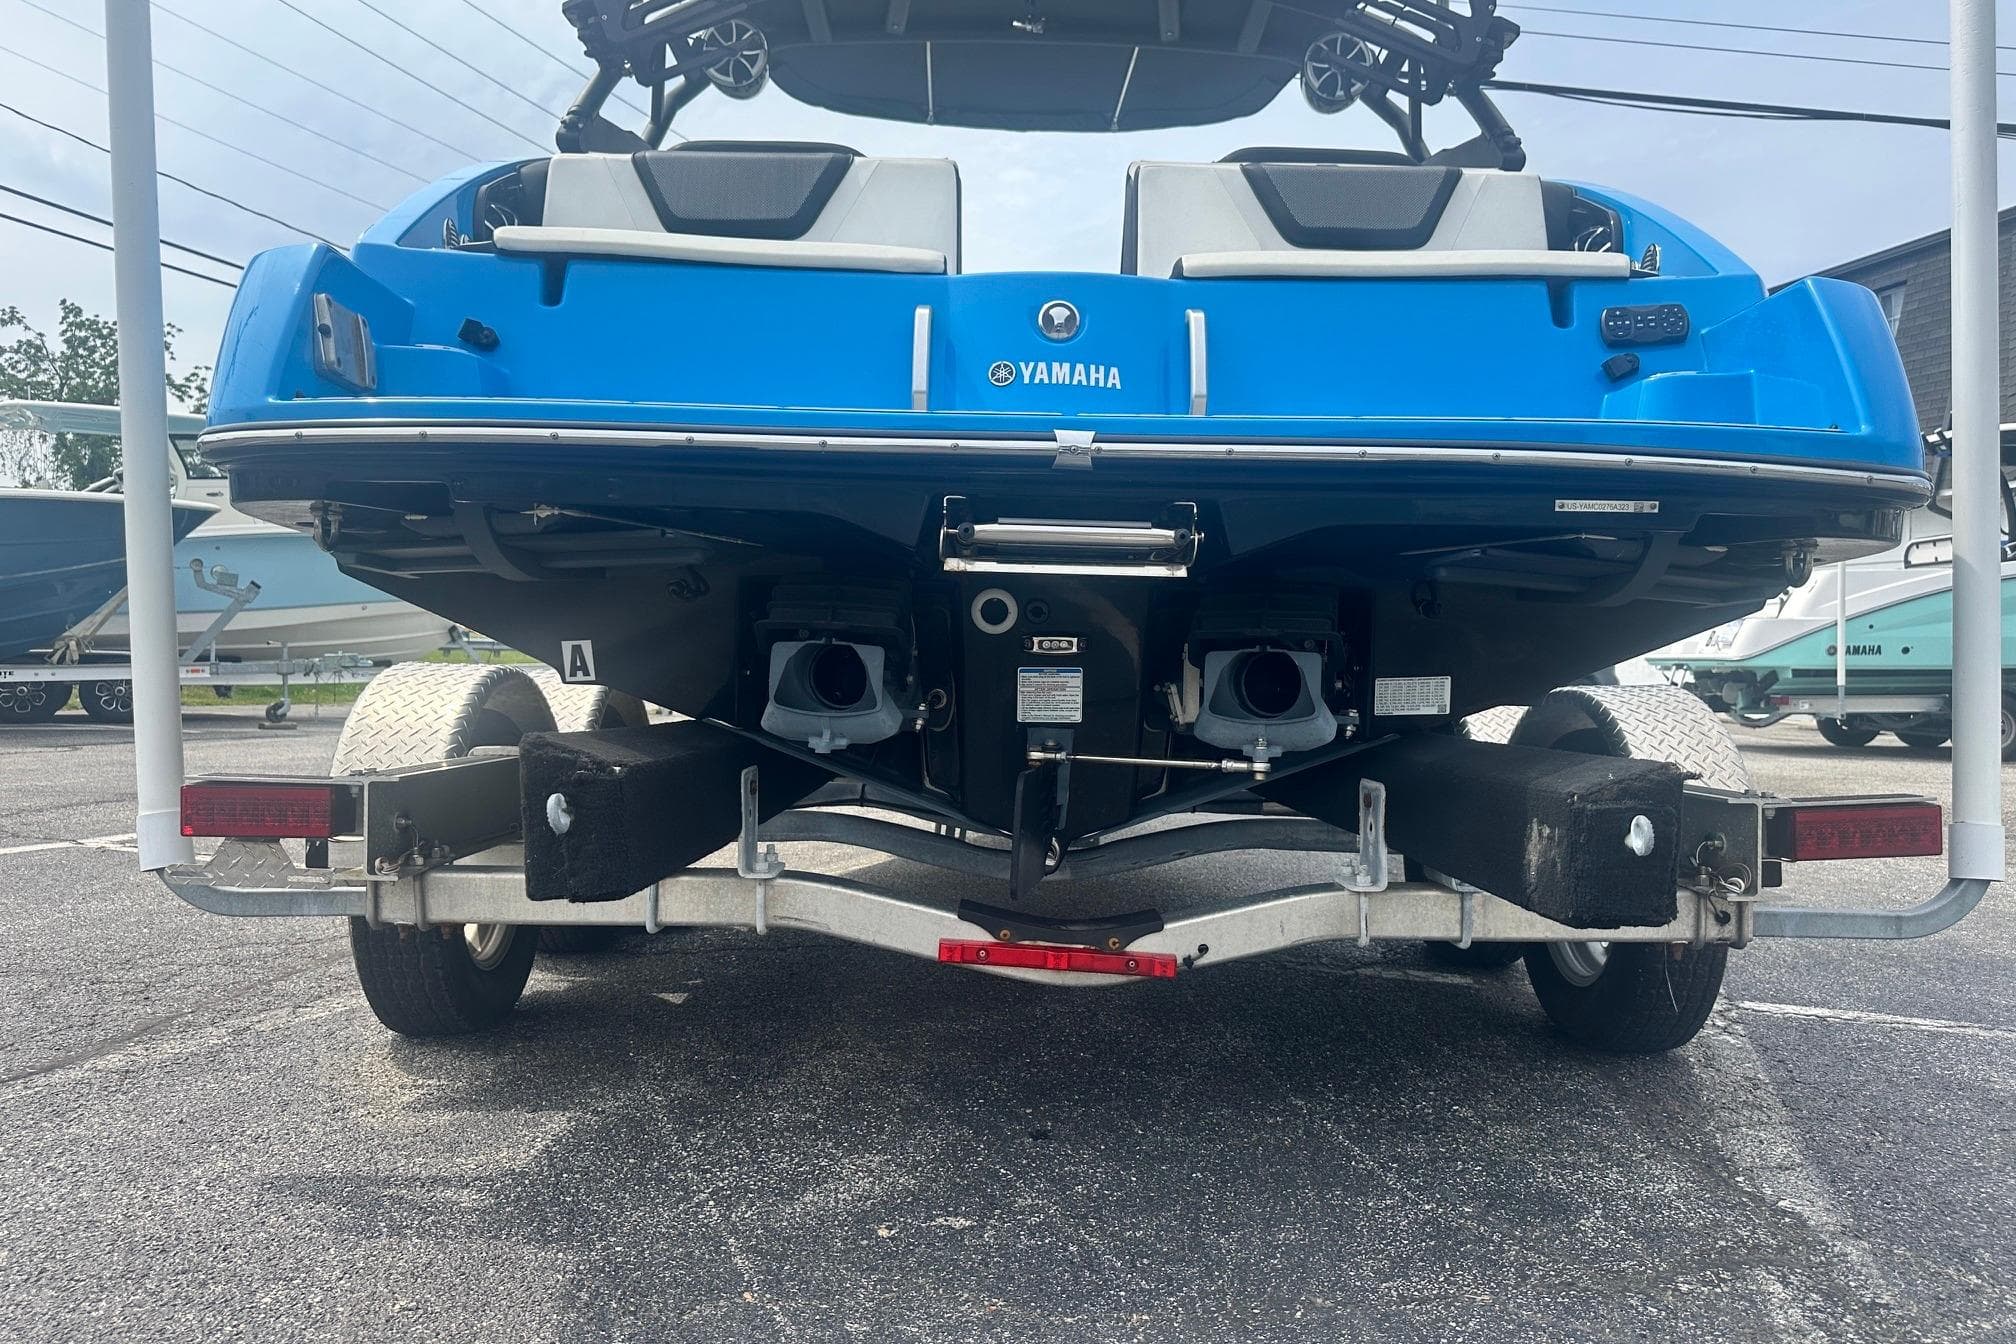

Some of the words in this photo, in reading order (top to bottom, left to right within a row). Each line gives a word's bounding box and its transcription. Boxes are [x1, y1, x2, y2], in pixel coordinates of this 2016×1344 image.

[1019, 361, 1122, 390] YAMAHA
[569, 644, 591, 677] A
[1845, 644, 1882, 656] AMAHA
